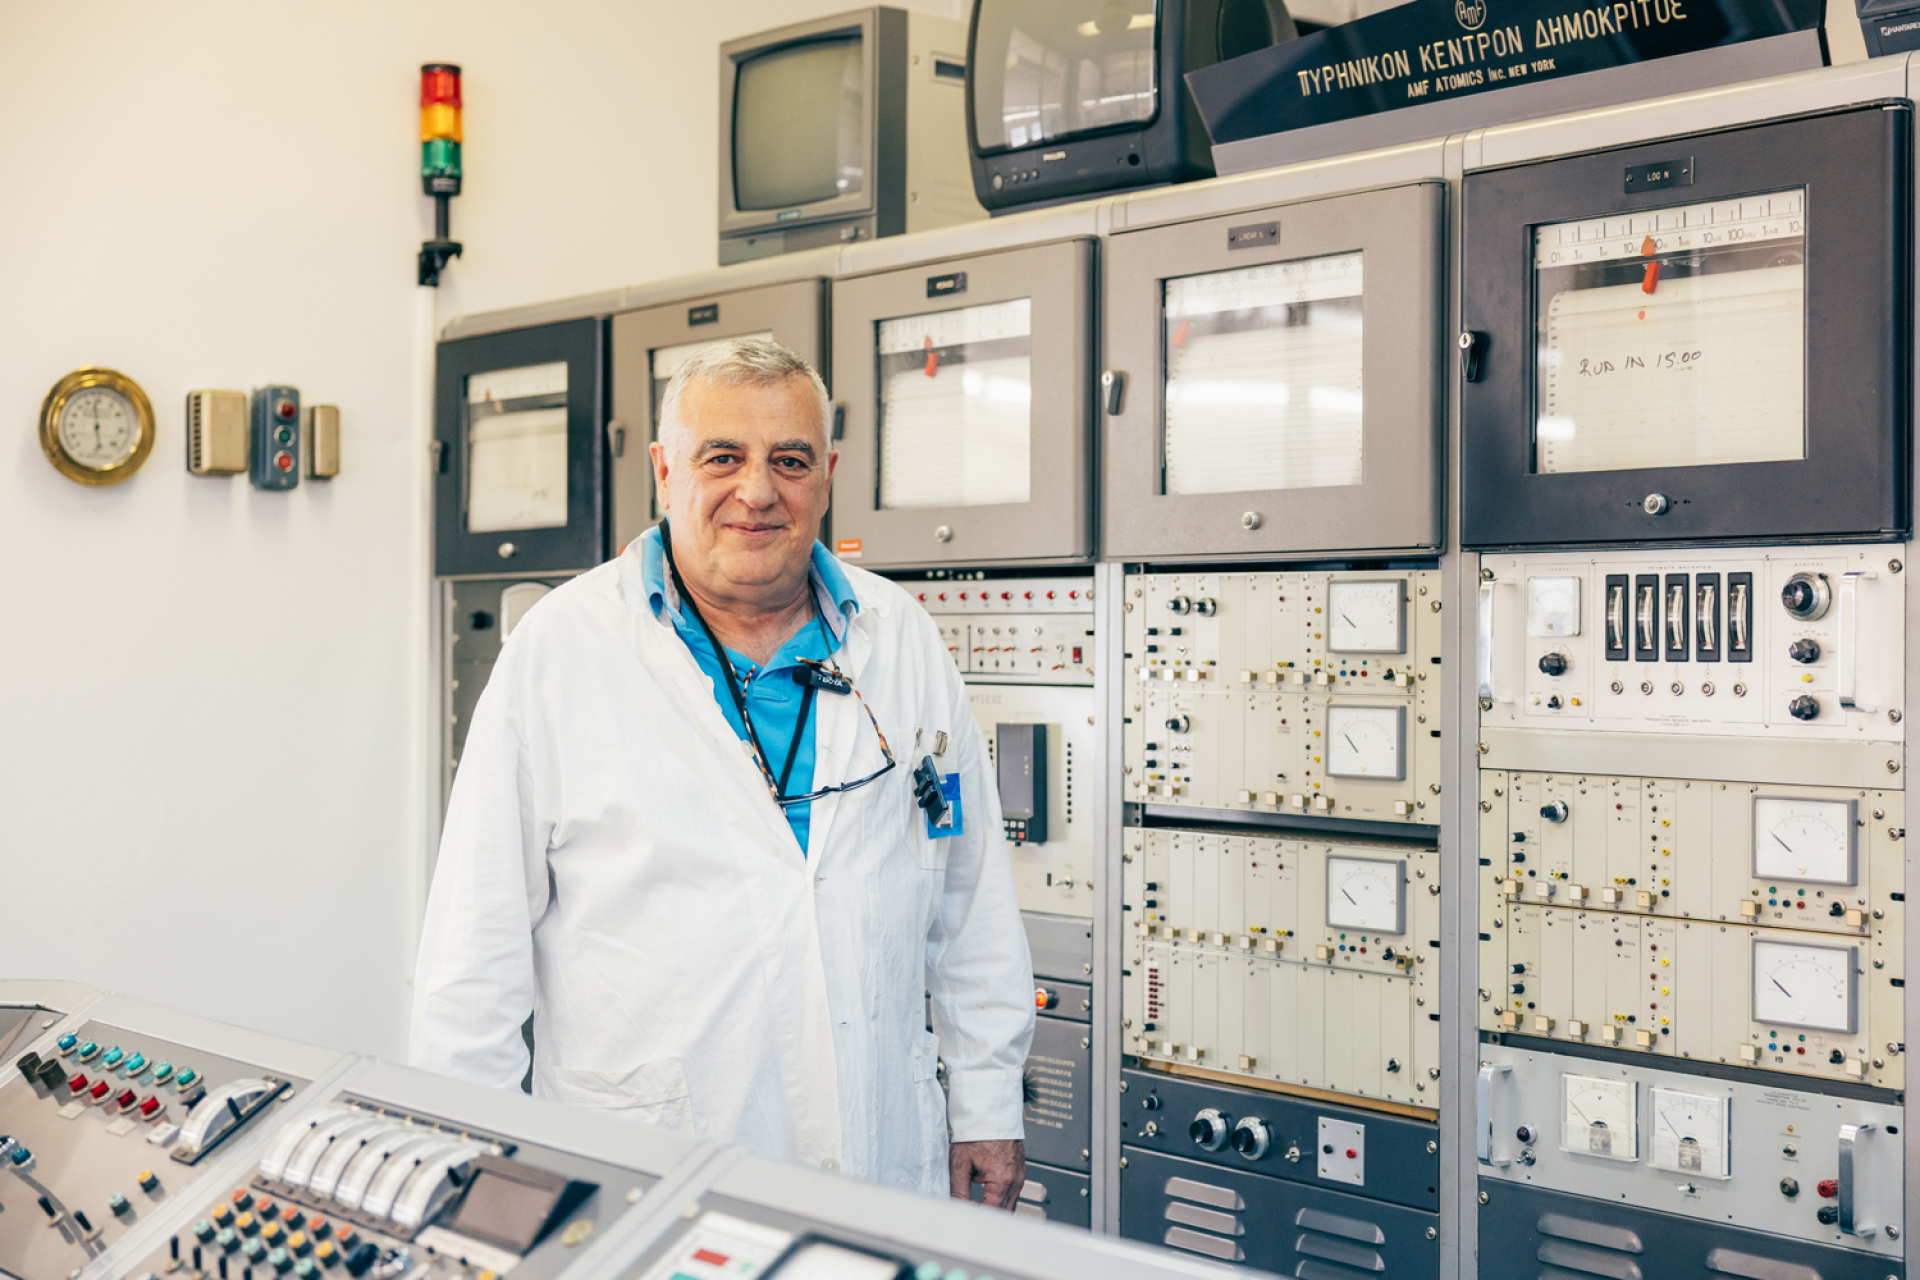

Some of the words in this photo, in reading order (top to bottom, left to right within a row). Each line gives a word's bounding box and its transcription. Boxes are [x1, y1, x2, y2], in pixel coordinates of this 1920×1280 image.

[1297, 49, 1411, 97] ΠΥΡΗΝΙΚΟΝ
[1418, 25, 1524, 73] ΚΕΝΤΡΟΝ
[1407, 79, 1430, 98] AMF
[1435, 67, 1484, 93] ATOMICS
[1508, 63, 1528, 79] NEW
[1530, 58, 1556, 74] YORK
[1646, 171, 1661, 182] LOG
[1624, 355, 1646, 370] IN
